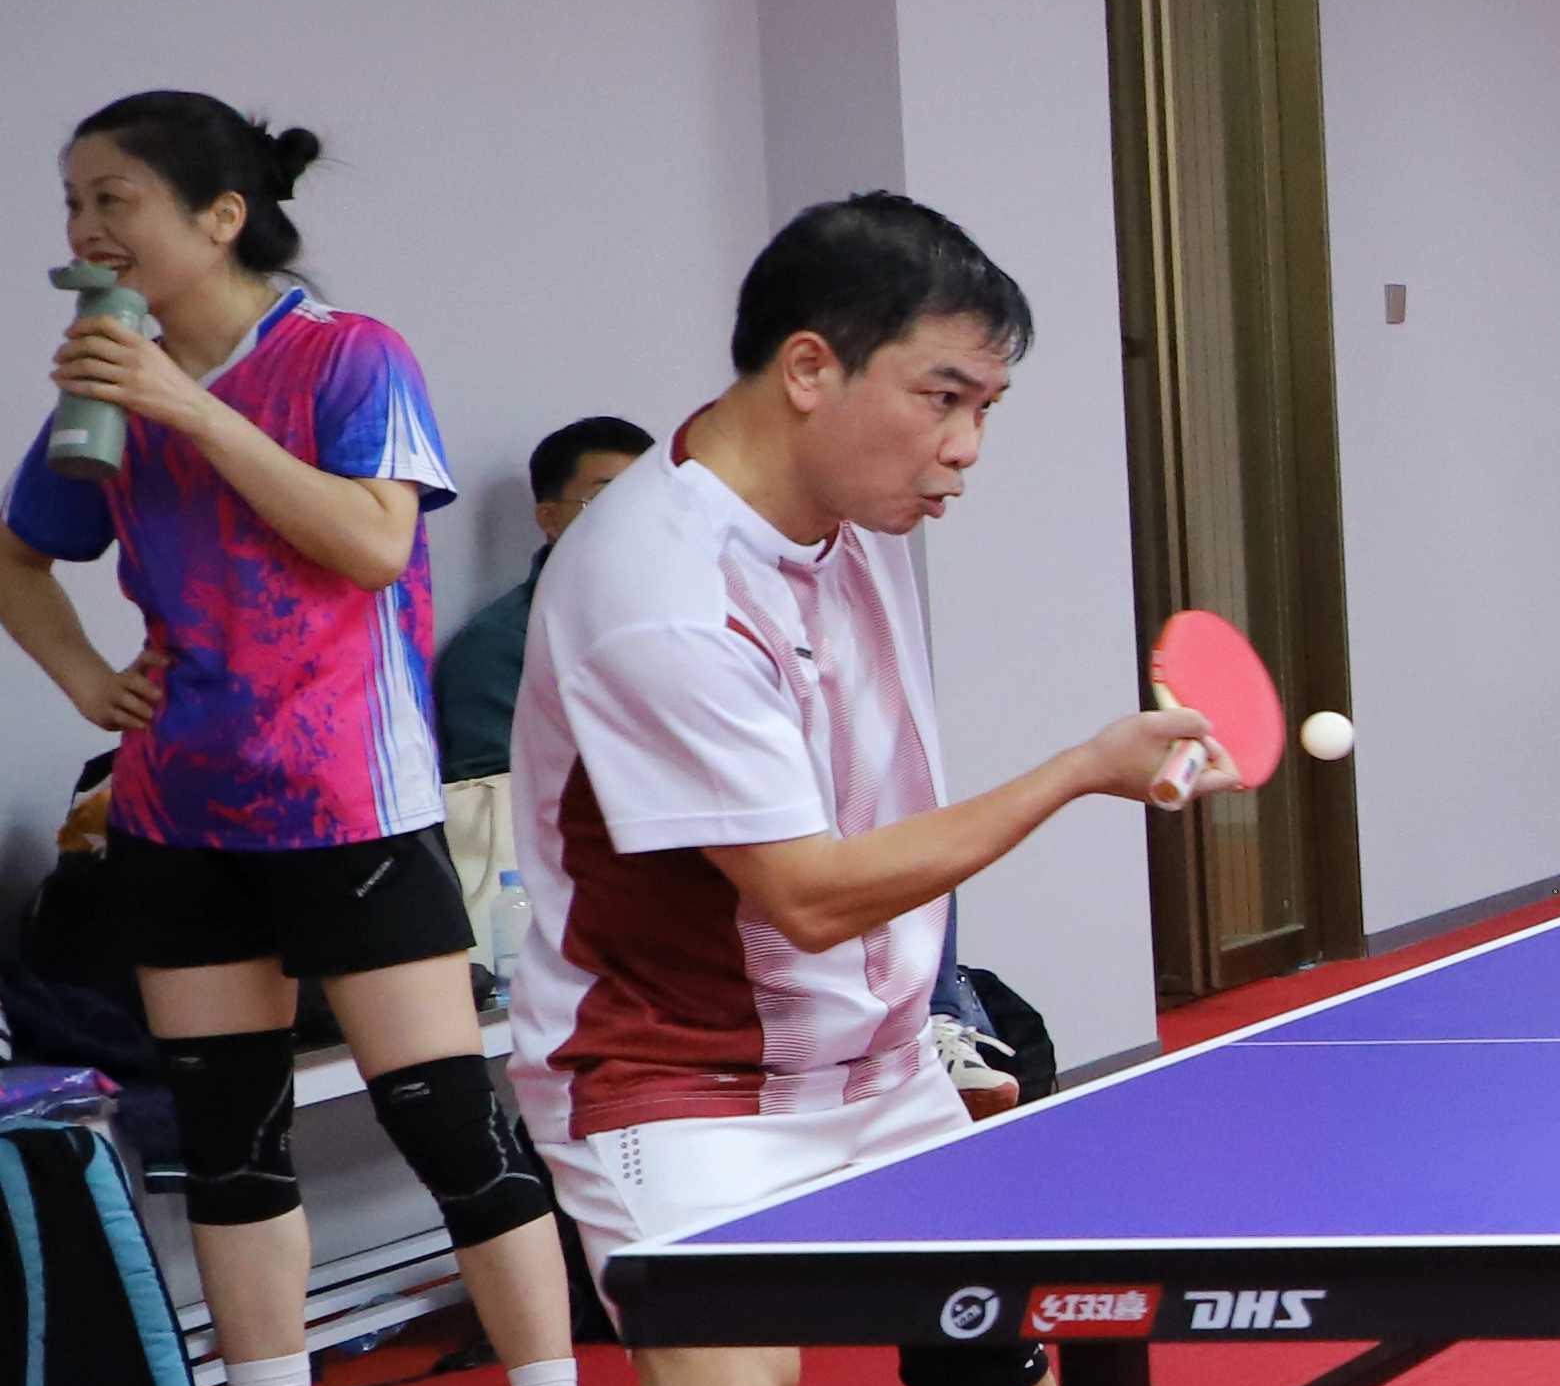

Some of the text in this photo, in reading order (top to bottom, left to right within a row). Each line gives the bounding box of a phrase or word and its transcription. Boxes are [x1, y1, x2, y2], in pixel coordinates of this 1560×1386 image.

[1032, 1290, 1327, 1332] 红双喜 DHS
